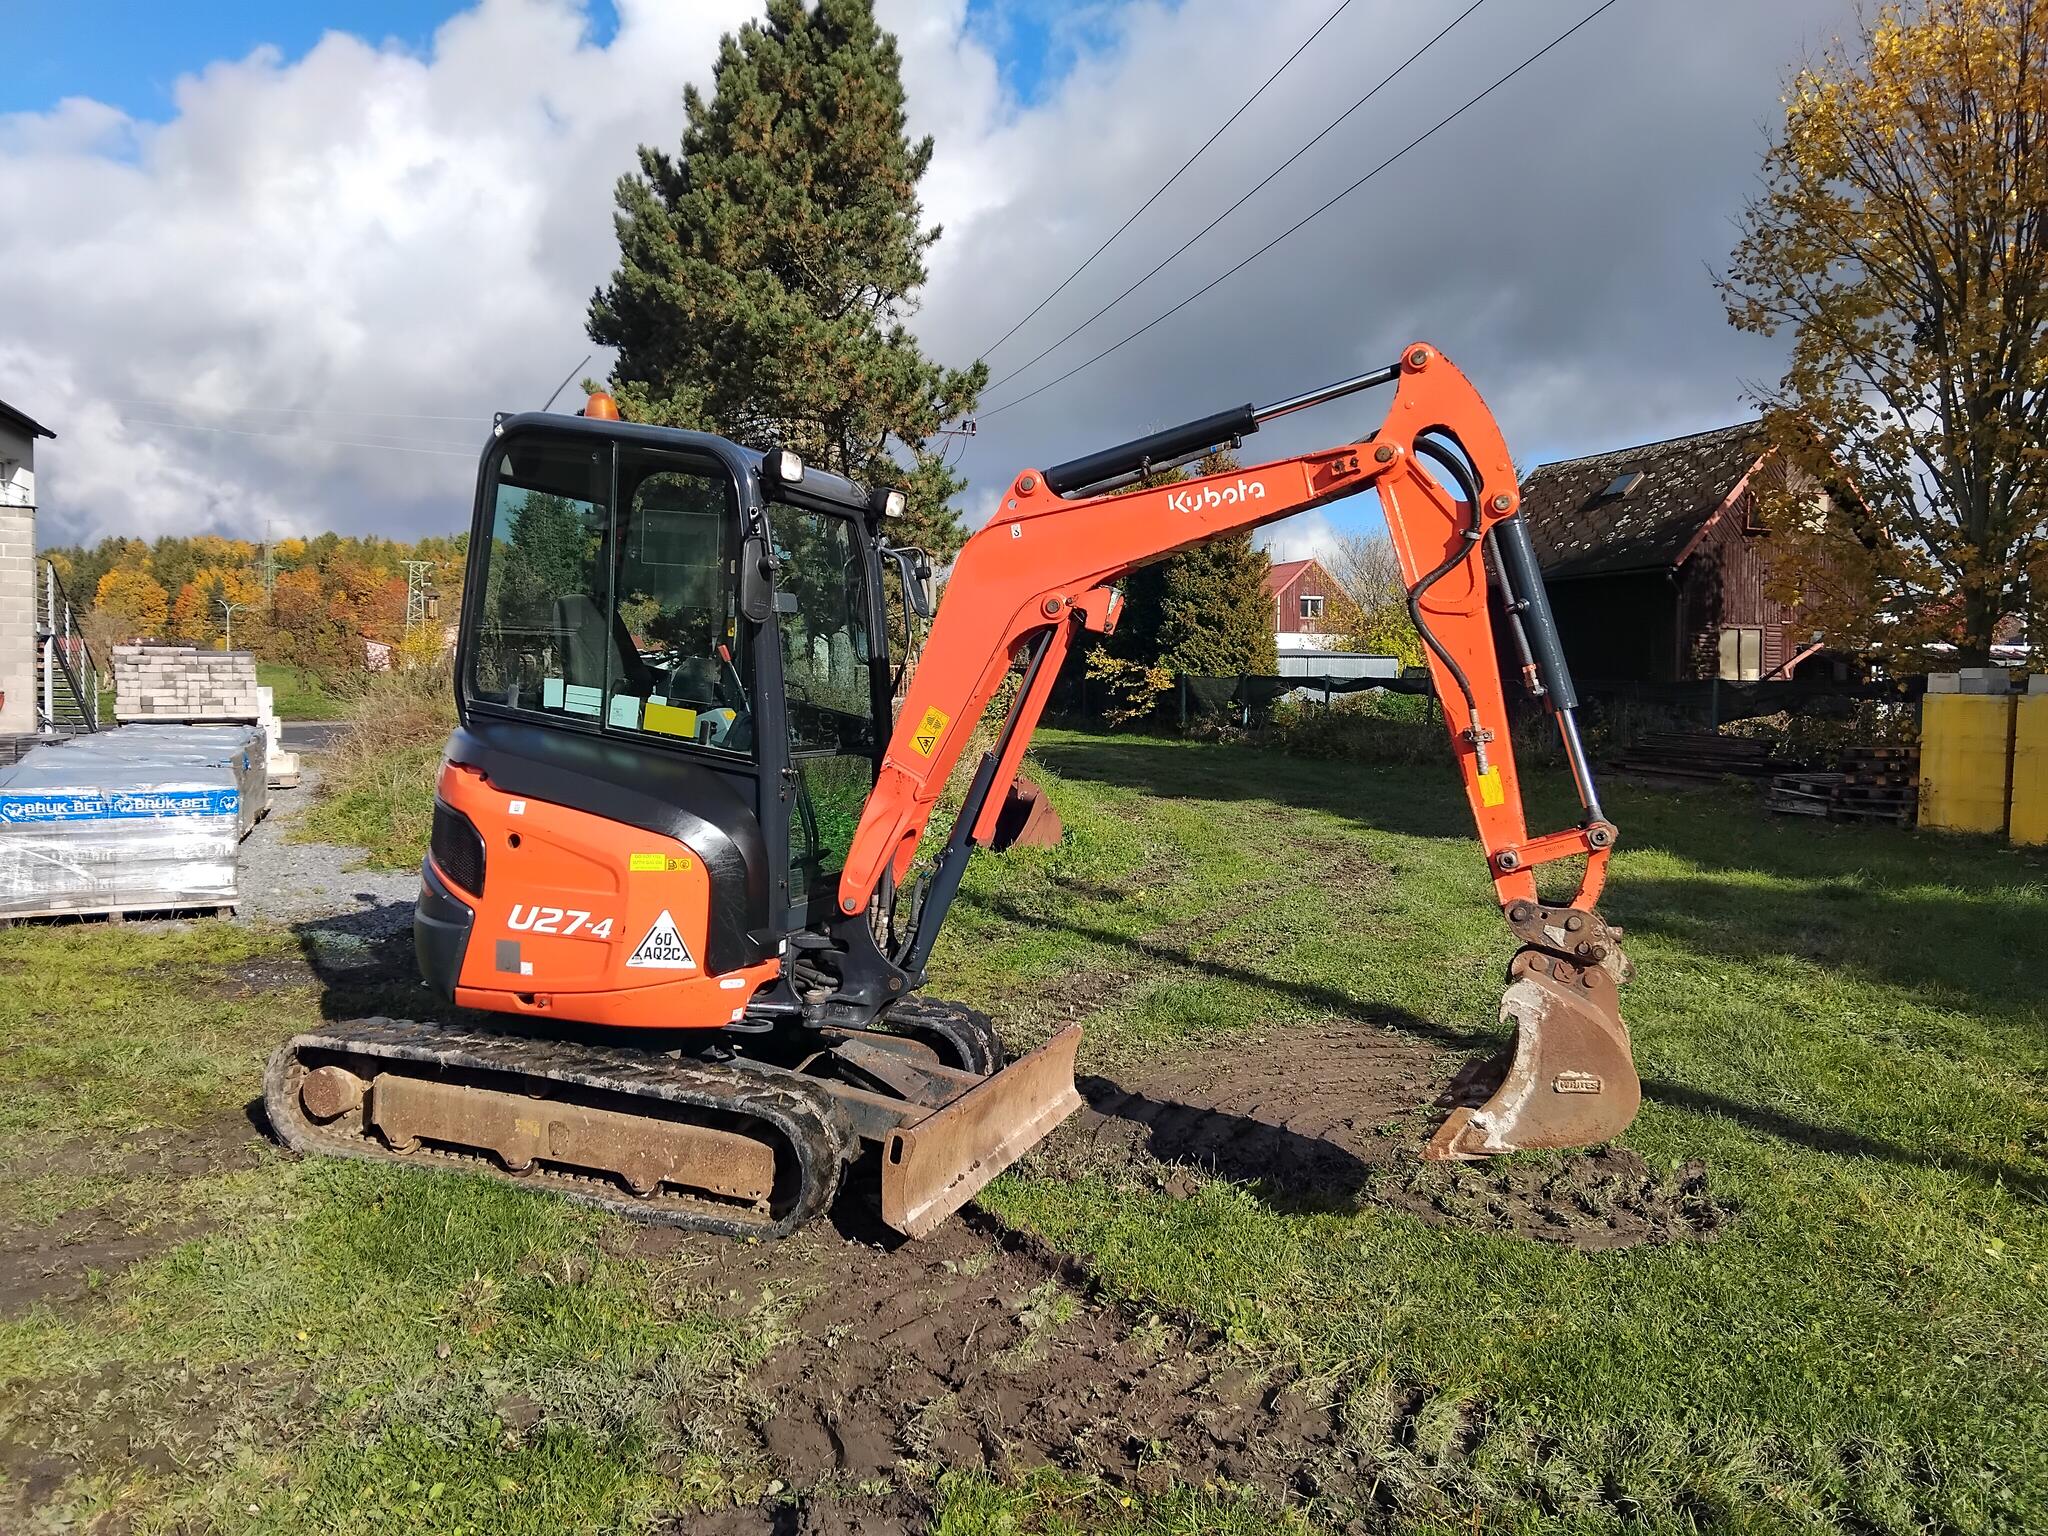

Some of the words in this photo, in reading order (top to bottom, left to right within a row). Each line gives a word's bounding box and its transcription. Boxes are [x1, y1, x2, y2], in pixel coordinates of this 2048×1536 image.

[1167, 479, 1266, 513] Kubota
[24, 800, 101, 813] BRUK-BET
[135, 797, 210, 810] BRUK-BET
[507, 904, 614, 938] U27-4
[643, 947, 681, 961] AQ2C
